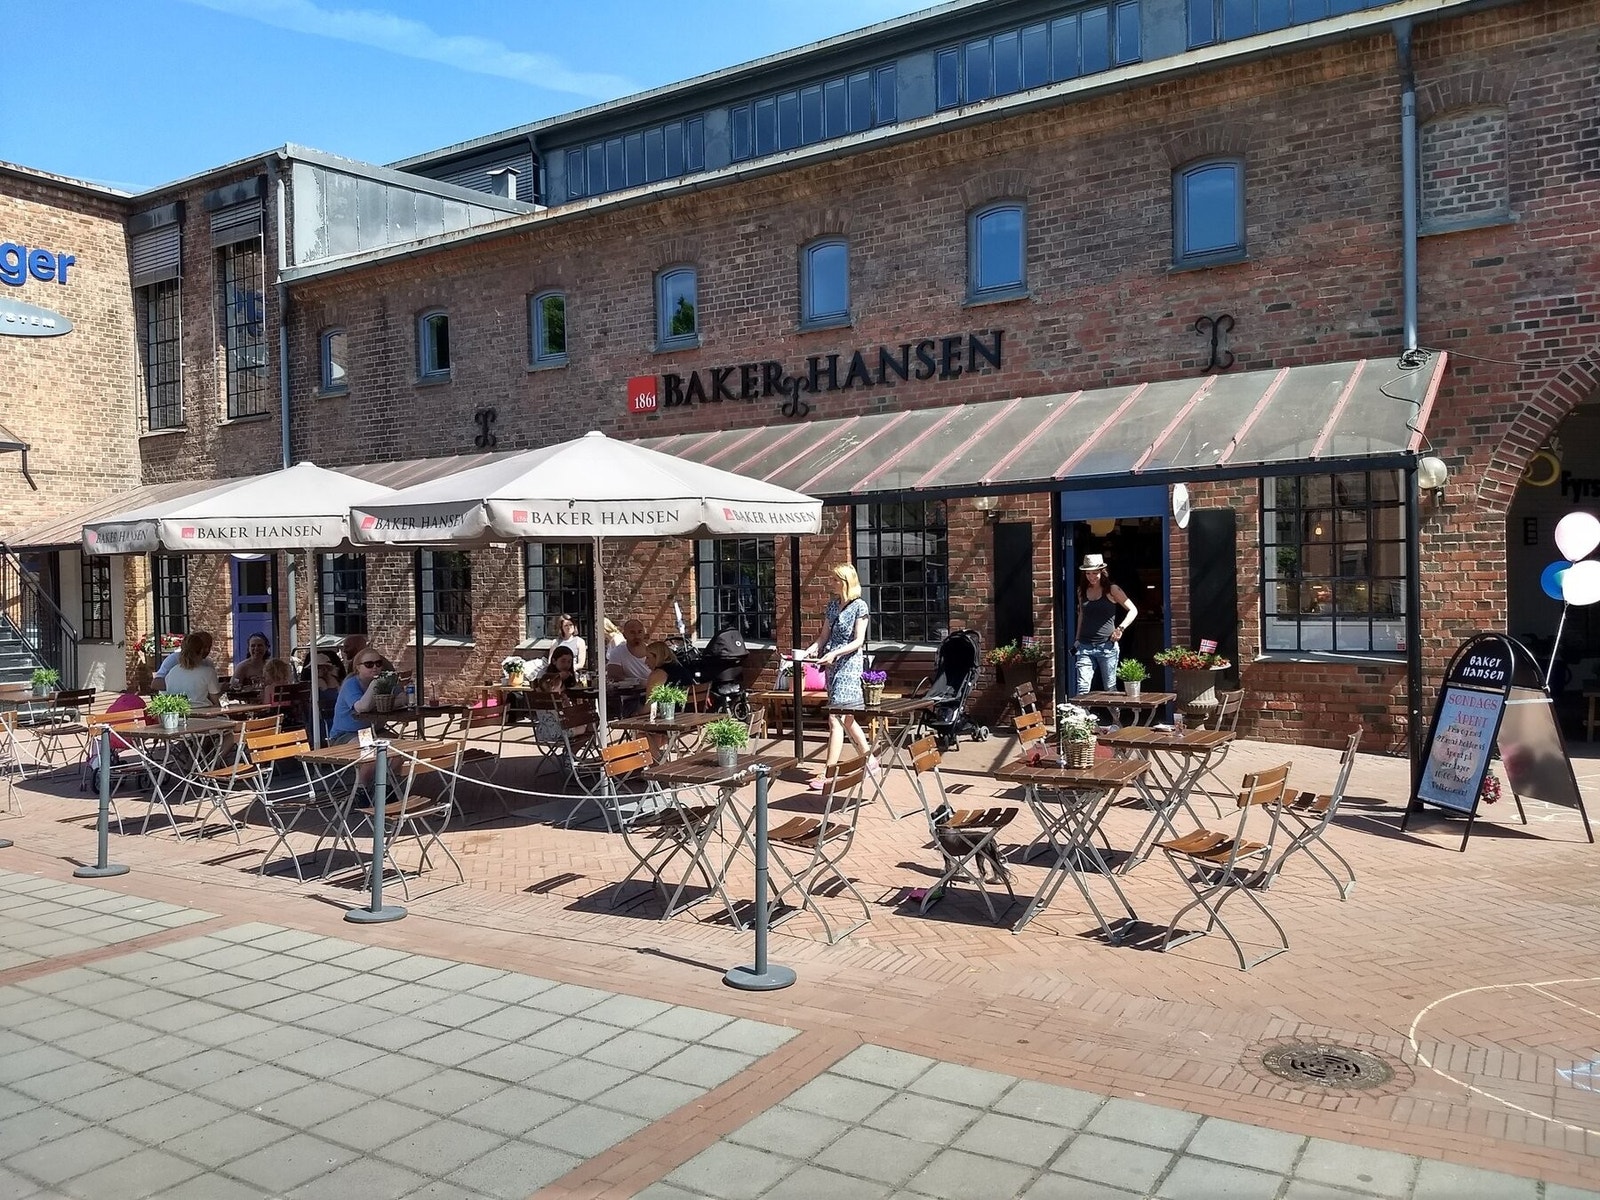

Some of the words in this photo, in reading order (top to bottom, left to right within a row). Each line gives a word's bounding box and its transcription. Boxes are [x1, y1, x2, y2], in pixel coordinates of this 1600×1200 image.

[0, 242, 76, 287] ger
[0, 311, 55, 328] STEM
[635, 391, 656, 409] 1861
[662, 360, 788, 408] BAKER
[806, 330, 1005, 393] HANSEN
[375, 517, 416, 530] BAKER
[532, 512, 594, 525] BAKER
[602, 510, 680, 525] HANSEN
[732, 510, 768, 523] BAKER
[769, 512, 816, 524] HANSEN
[197, 527, 248, 539] BAKER
[256, 525, 323, 537] HANSEN
